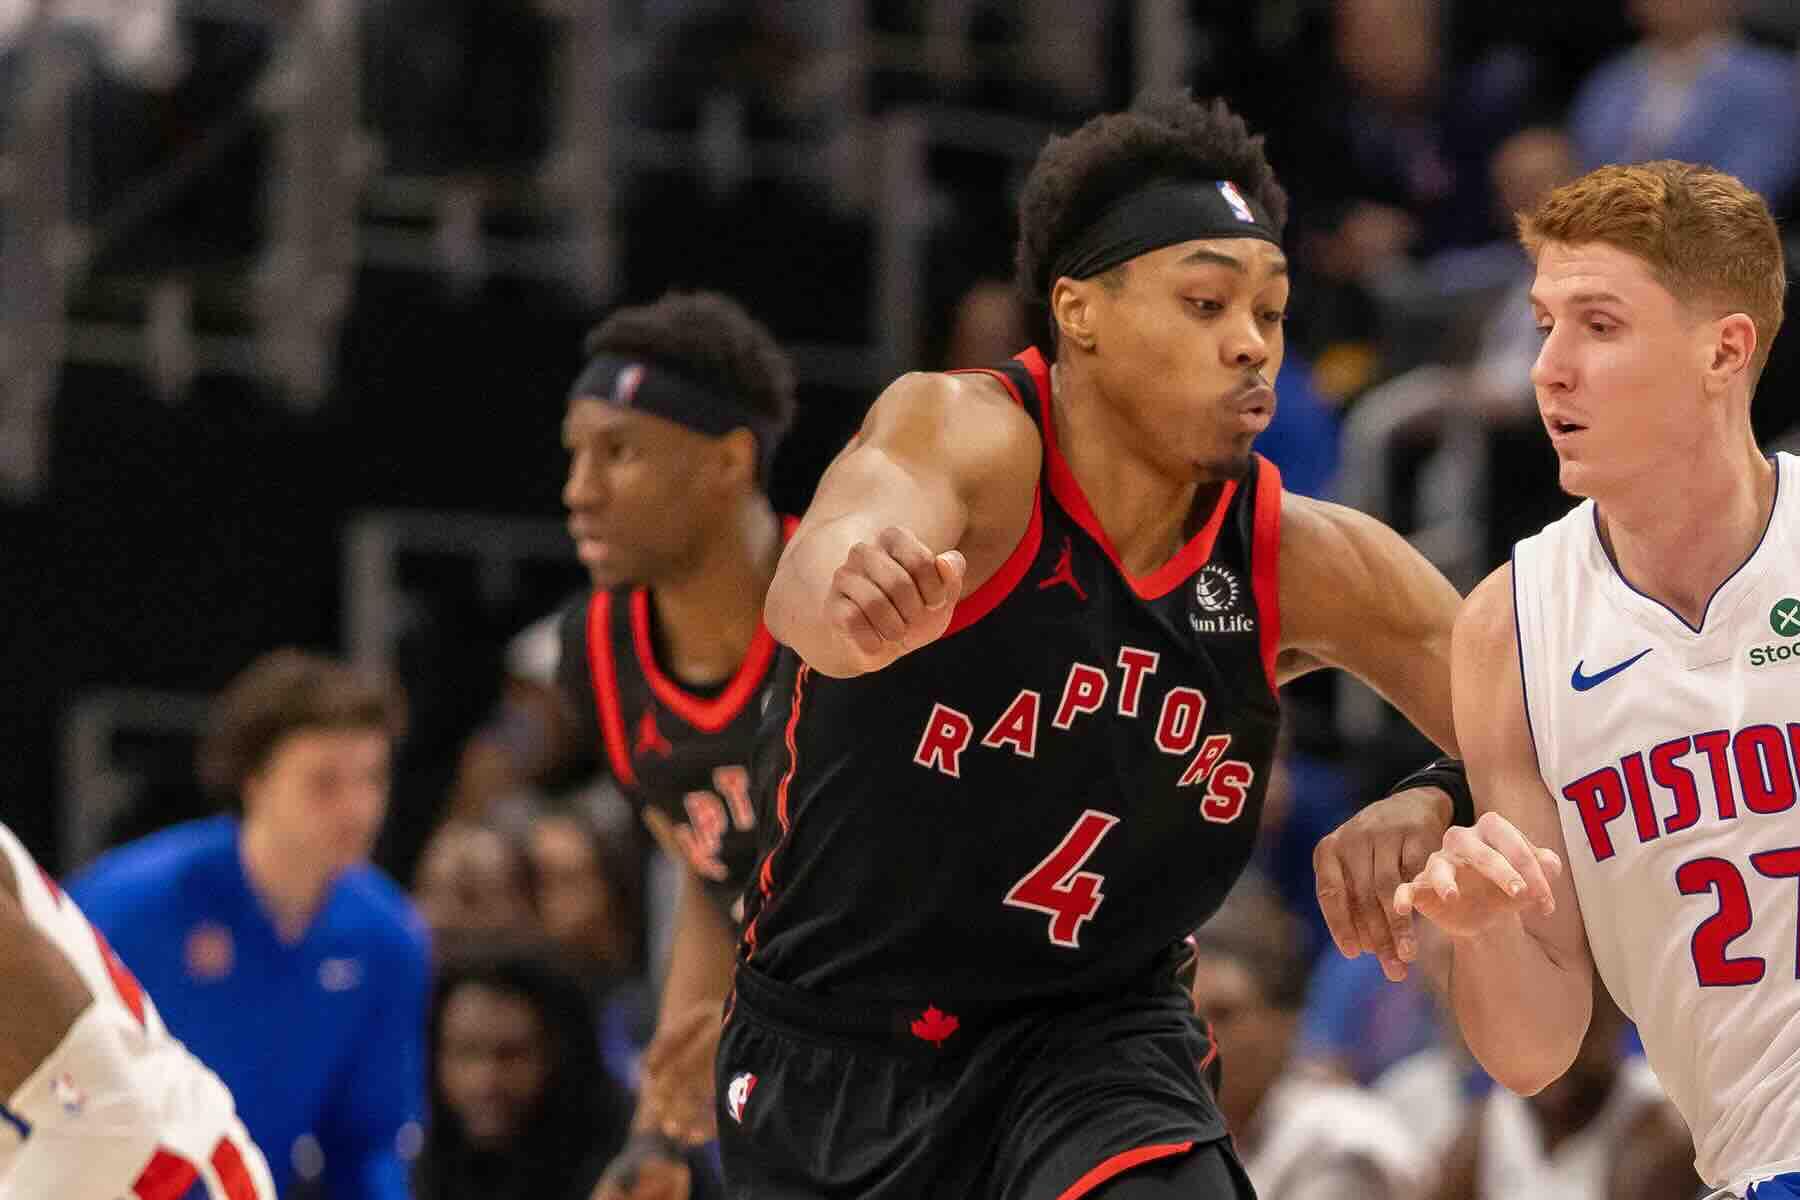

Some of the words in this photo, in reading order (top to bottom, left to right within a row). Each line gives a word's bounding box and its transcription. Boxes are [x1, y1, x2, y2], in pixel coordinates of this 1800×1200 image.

[1218, 613, 1254, 632] Life
[913, 646, 1255, 825] RAPTORS
[1003, 809, 1120, 948] 4
